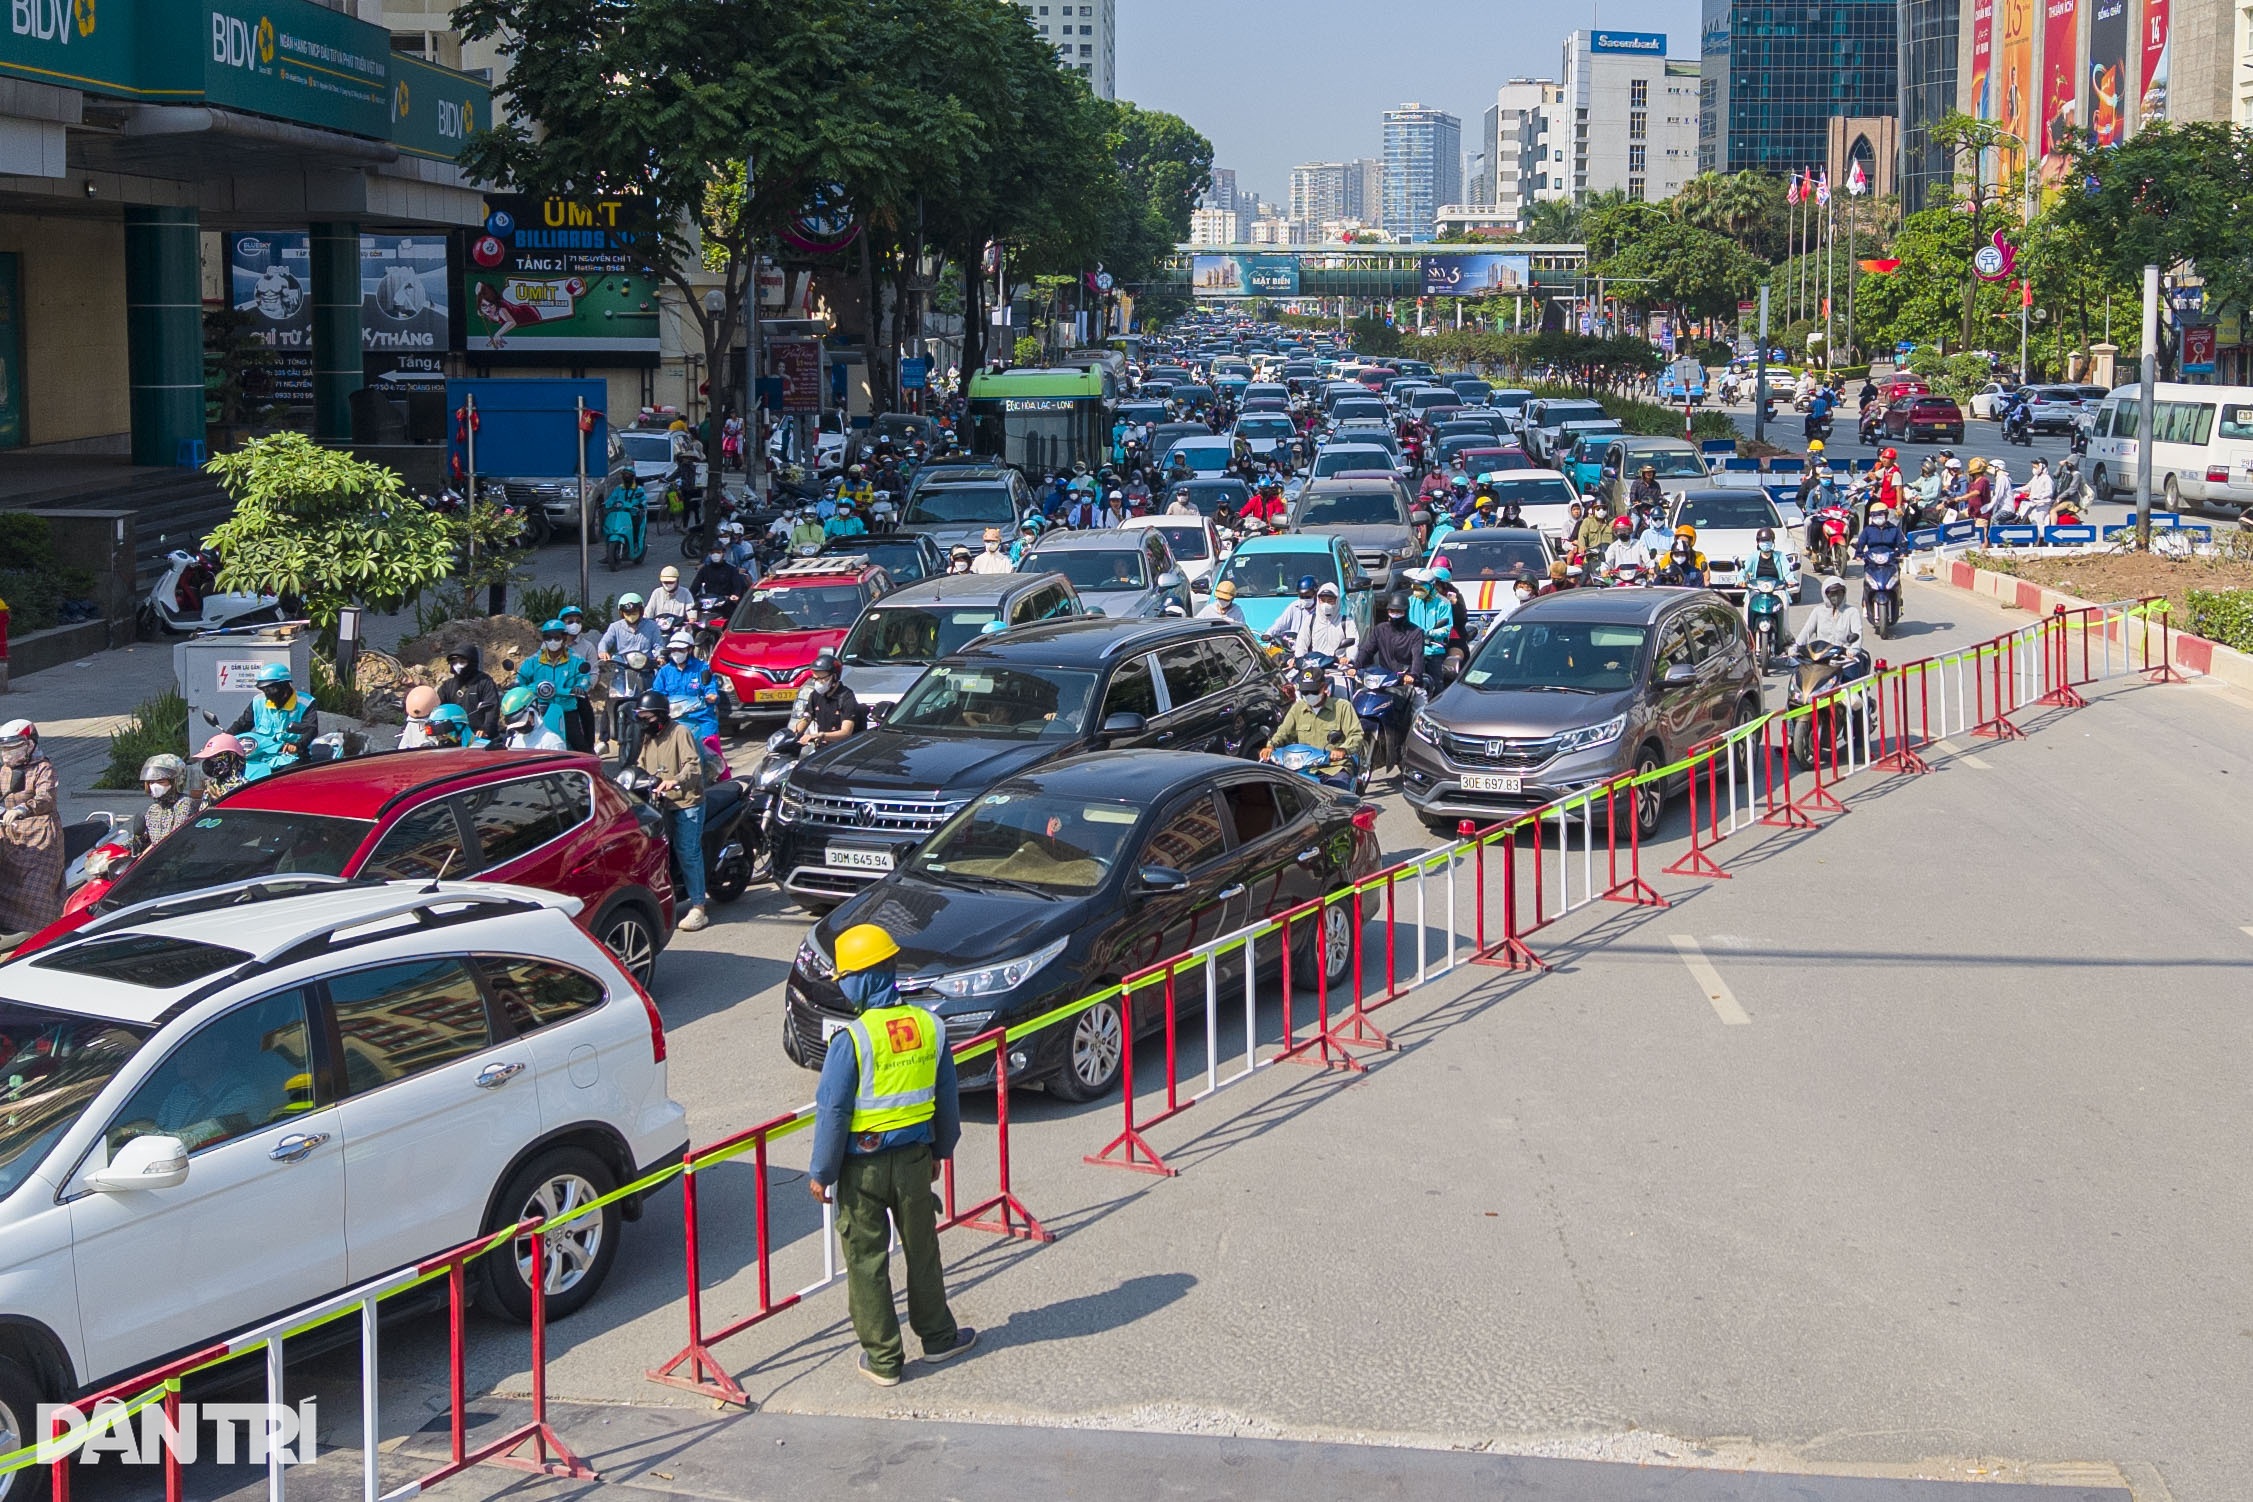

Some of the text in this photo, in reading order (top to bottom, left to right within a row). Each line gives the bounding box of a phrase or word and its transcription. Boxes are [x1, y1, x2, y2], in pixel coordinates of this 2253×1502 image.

[12, 0, 73, 45] BIDV
[212, 11, 259, 71] BIDV
[1598, 34, 1660, 49] Sacombank
[438, 99, 464, 139] BIDV
[515, 230, 605, 249] BILLIARDS
[554, 260, 562, 271] 2
[433, 359, 442, 371] 4
